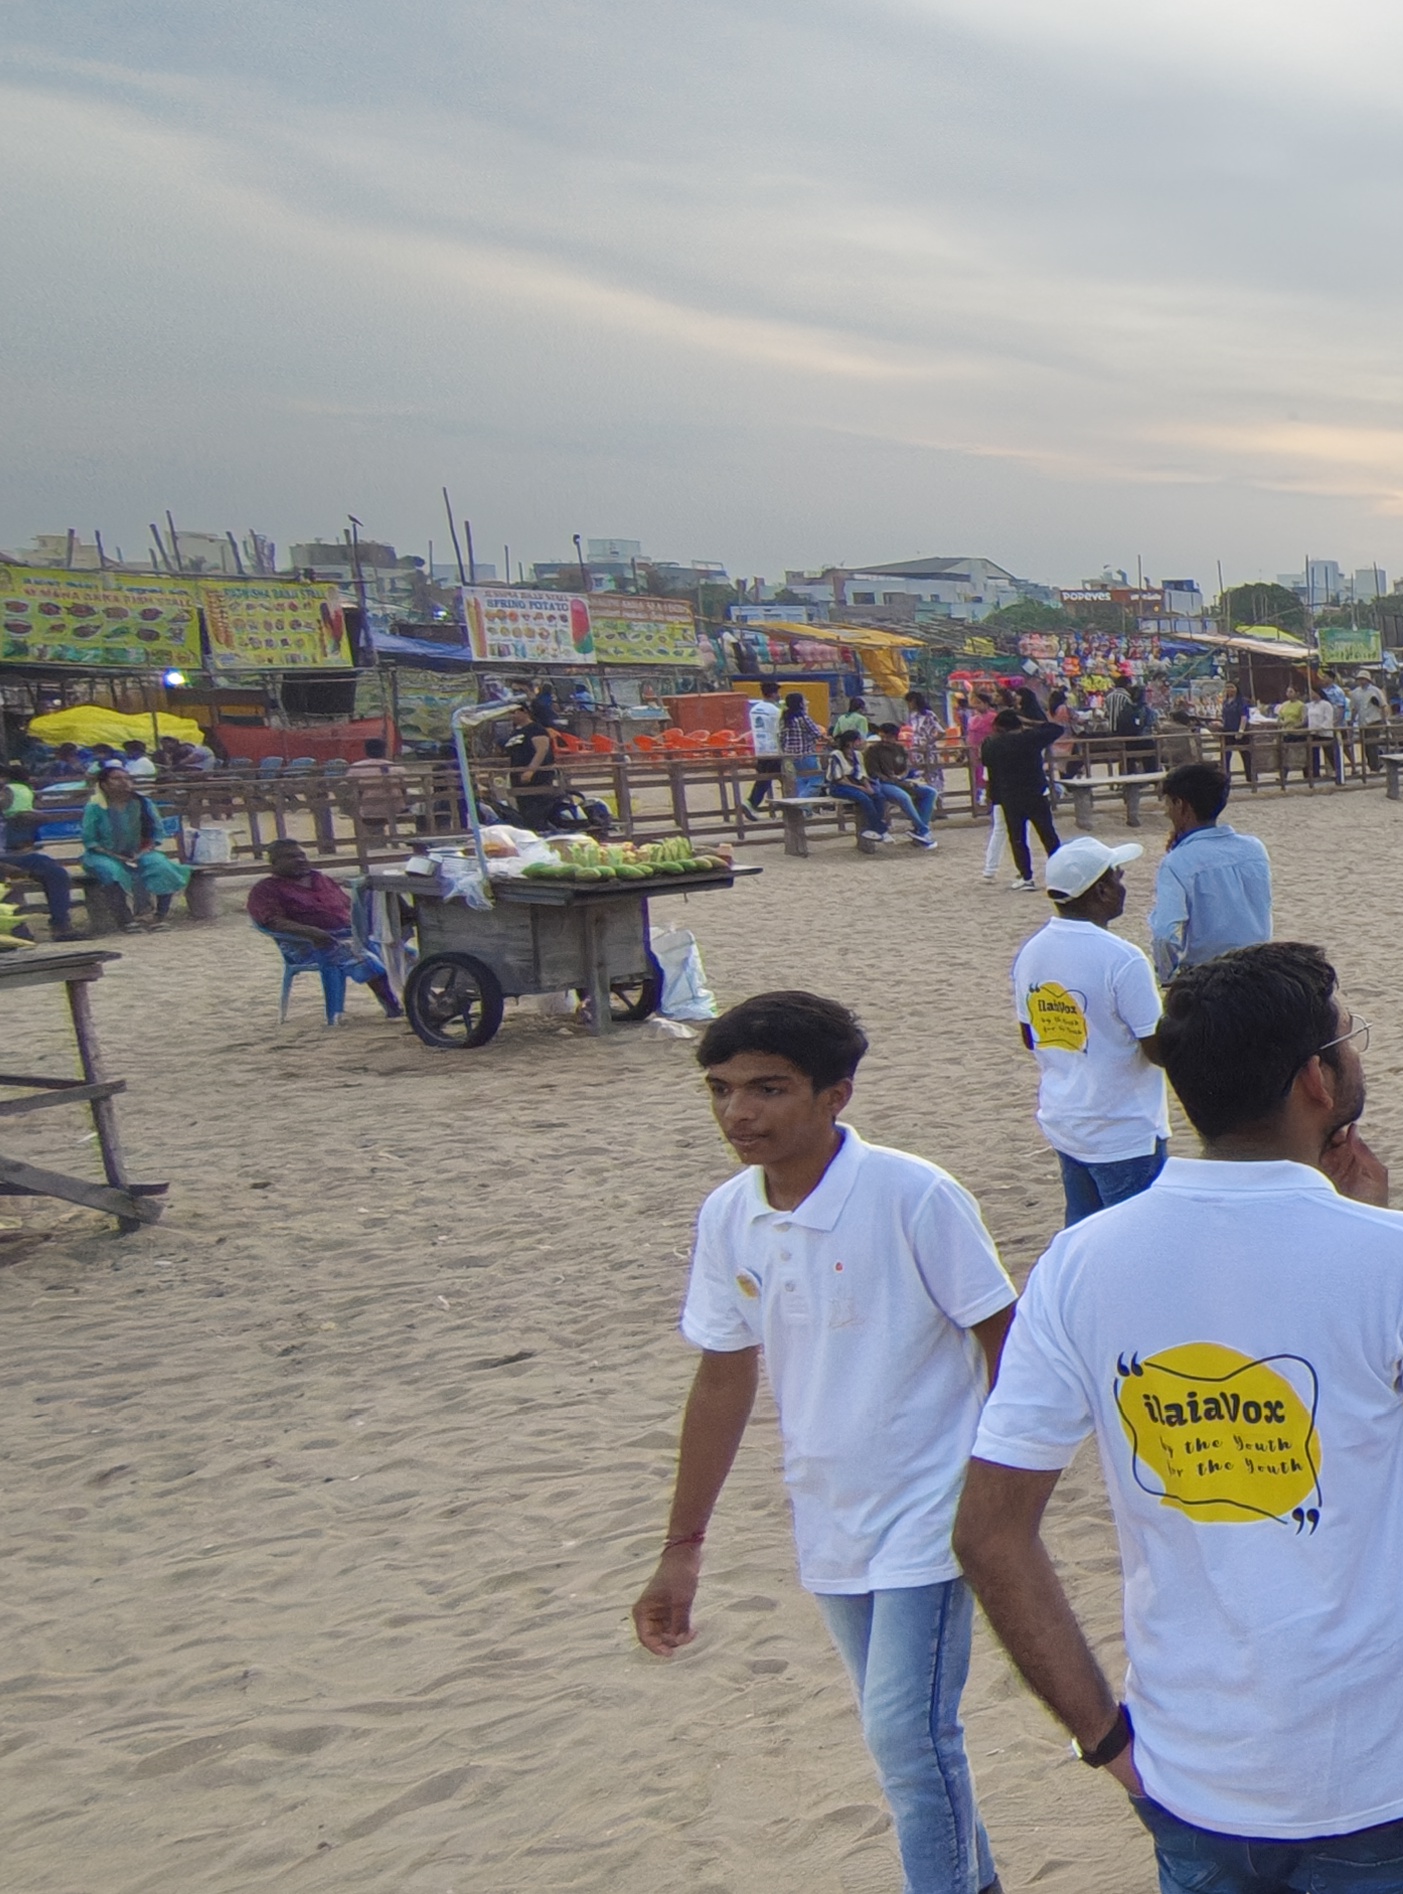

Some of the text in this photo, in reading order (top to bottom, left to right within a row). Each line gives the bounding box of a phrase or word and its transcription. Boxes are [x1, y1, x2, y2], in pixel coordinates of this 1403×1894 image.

[1184, 1437, 1223, 1455] the
[1233, 1433, 1293, 1452] Youth
[1197, 1459, 1234, 1477] the
[1244, 1457, 1303, 1475] Youth
